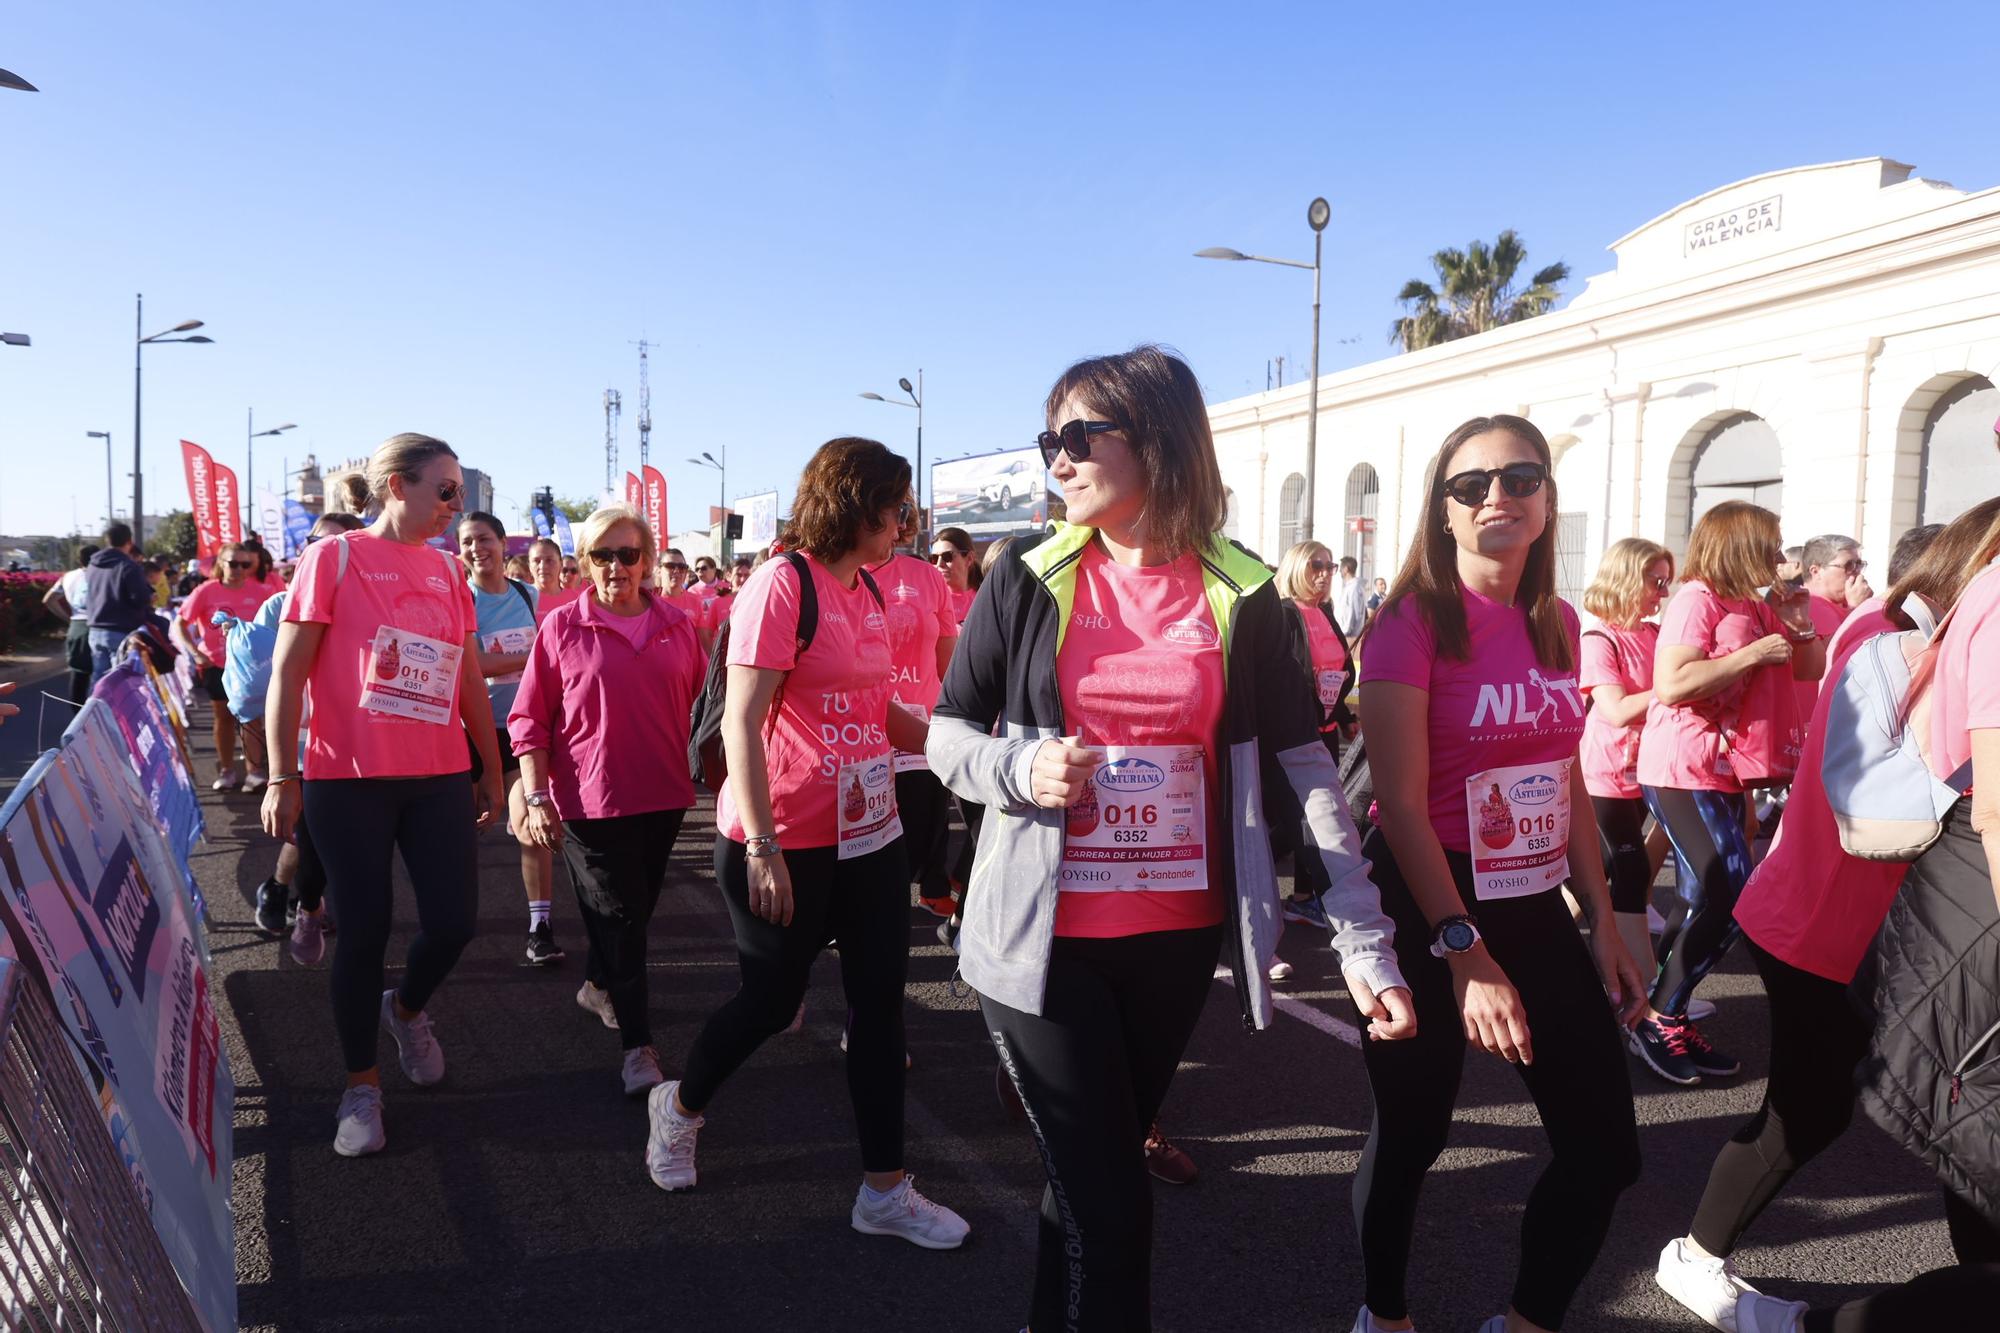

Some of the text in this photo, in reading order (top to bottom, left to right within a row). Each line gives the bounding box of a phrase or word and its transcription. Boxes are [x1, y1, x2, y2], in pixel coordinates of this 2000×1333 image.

[1693, 203, 1771, 236] GRAO DE
[1690, 217, 1773, 250] VALENCIA
[1072, 611, 1112, 630] SHO
[1166, 627, 1213, 641] ASTURIANA
[401, 665, 430, 682] 016
[403, 680, 423, 691] 6351
[370, 696, 399, 708] OYSHO
[822, 692, 849, 714] TU
[822, 723, 888, 746] DORS
[1170, 764, 1195, 773] SUMA
[1101, 770, 1160, 783] ASTURIANA
[1514, 785, 1556, 799] ASTURIANA
[868, 791, 887, 809] 016
[1104, 804, 1157, 825] 016
[1519, 813, 1555, 835] 016
[1114, 830, 1148, 842] 6352
[1528, 836, 1550, 850] 6353
[847, 839, 873, 852] OYSHO
[1066, 849, 1192, 859] CARRERA DE LA MUJER 2023
[1490, 859, 1528, 869] CARRERA
[1528, 857, 1538, 865] DE
[1538, 855, 1546, 863] LA
[1062, 868, 1196, 881] OYSHO Santander
[1488, 876, 1529, 889] OYSHO
[993, 1031, 1018, 1078] new
[1068, 1261, 1087, 1321] since
